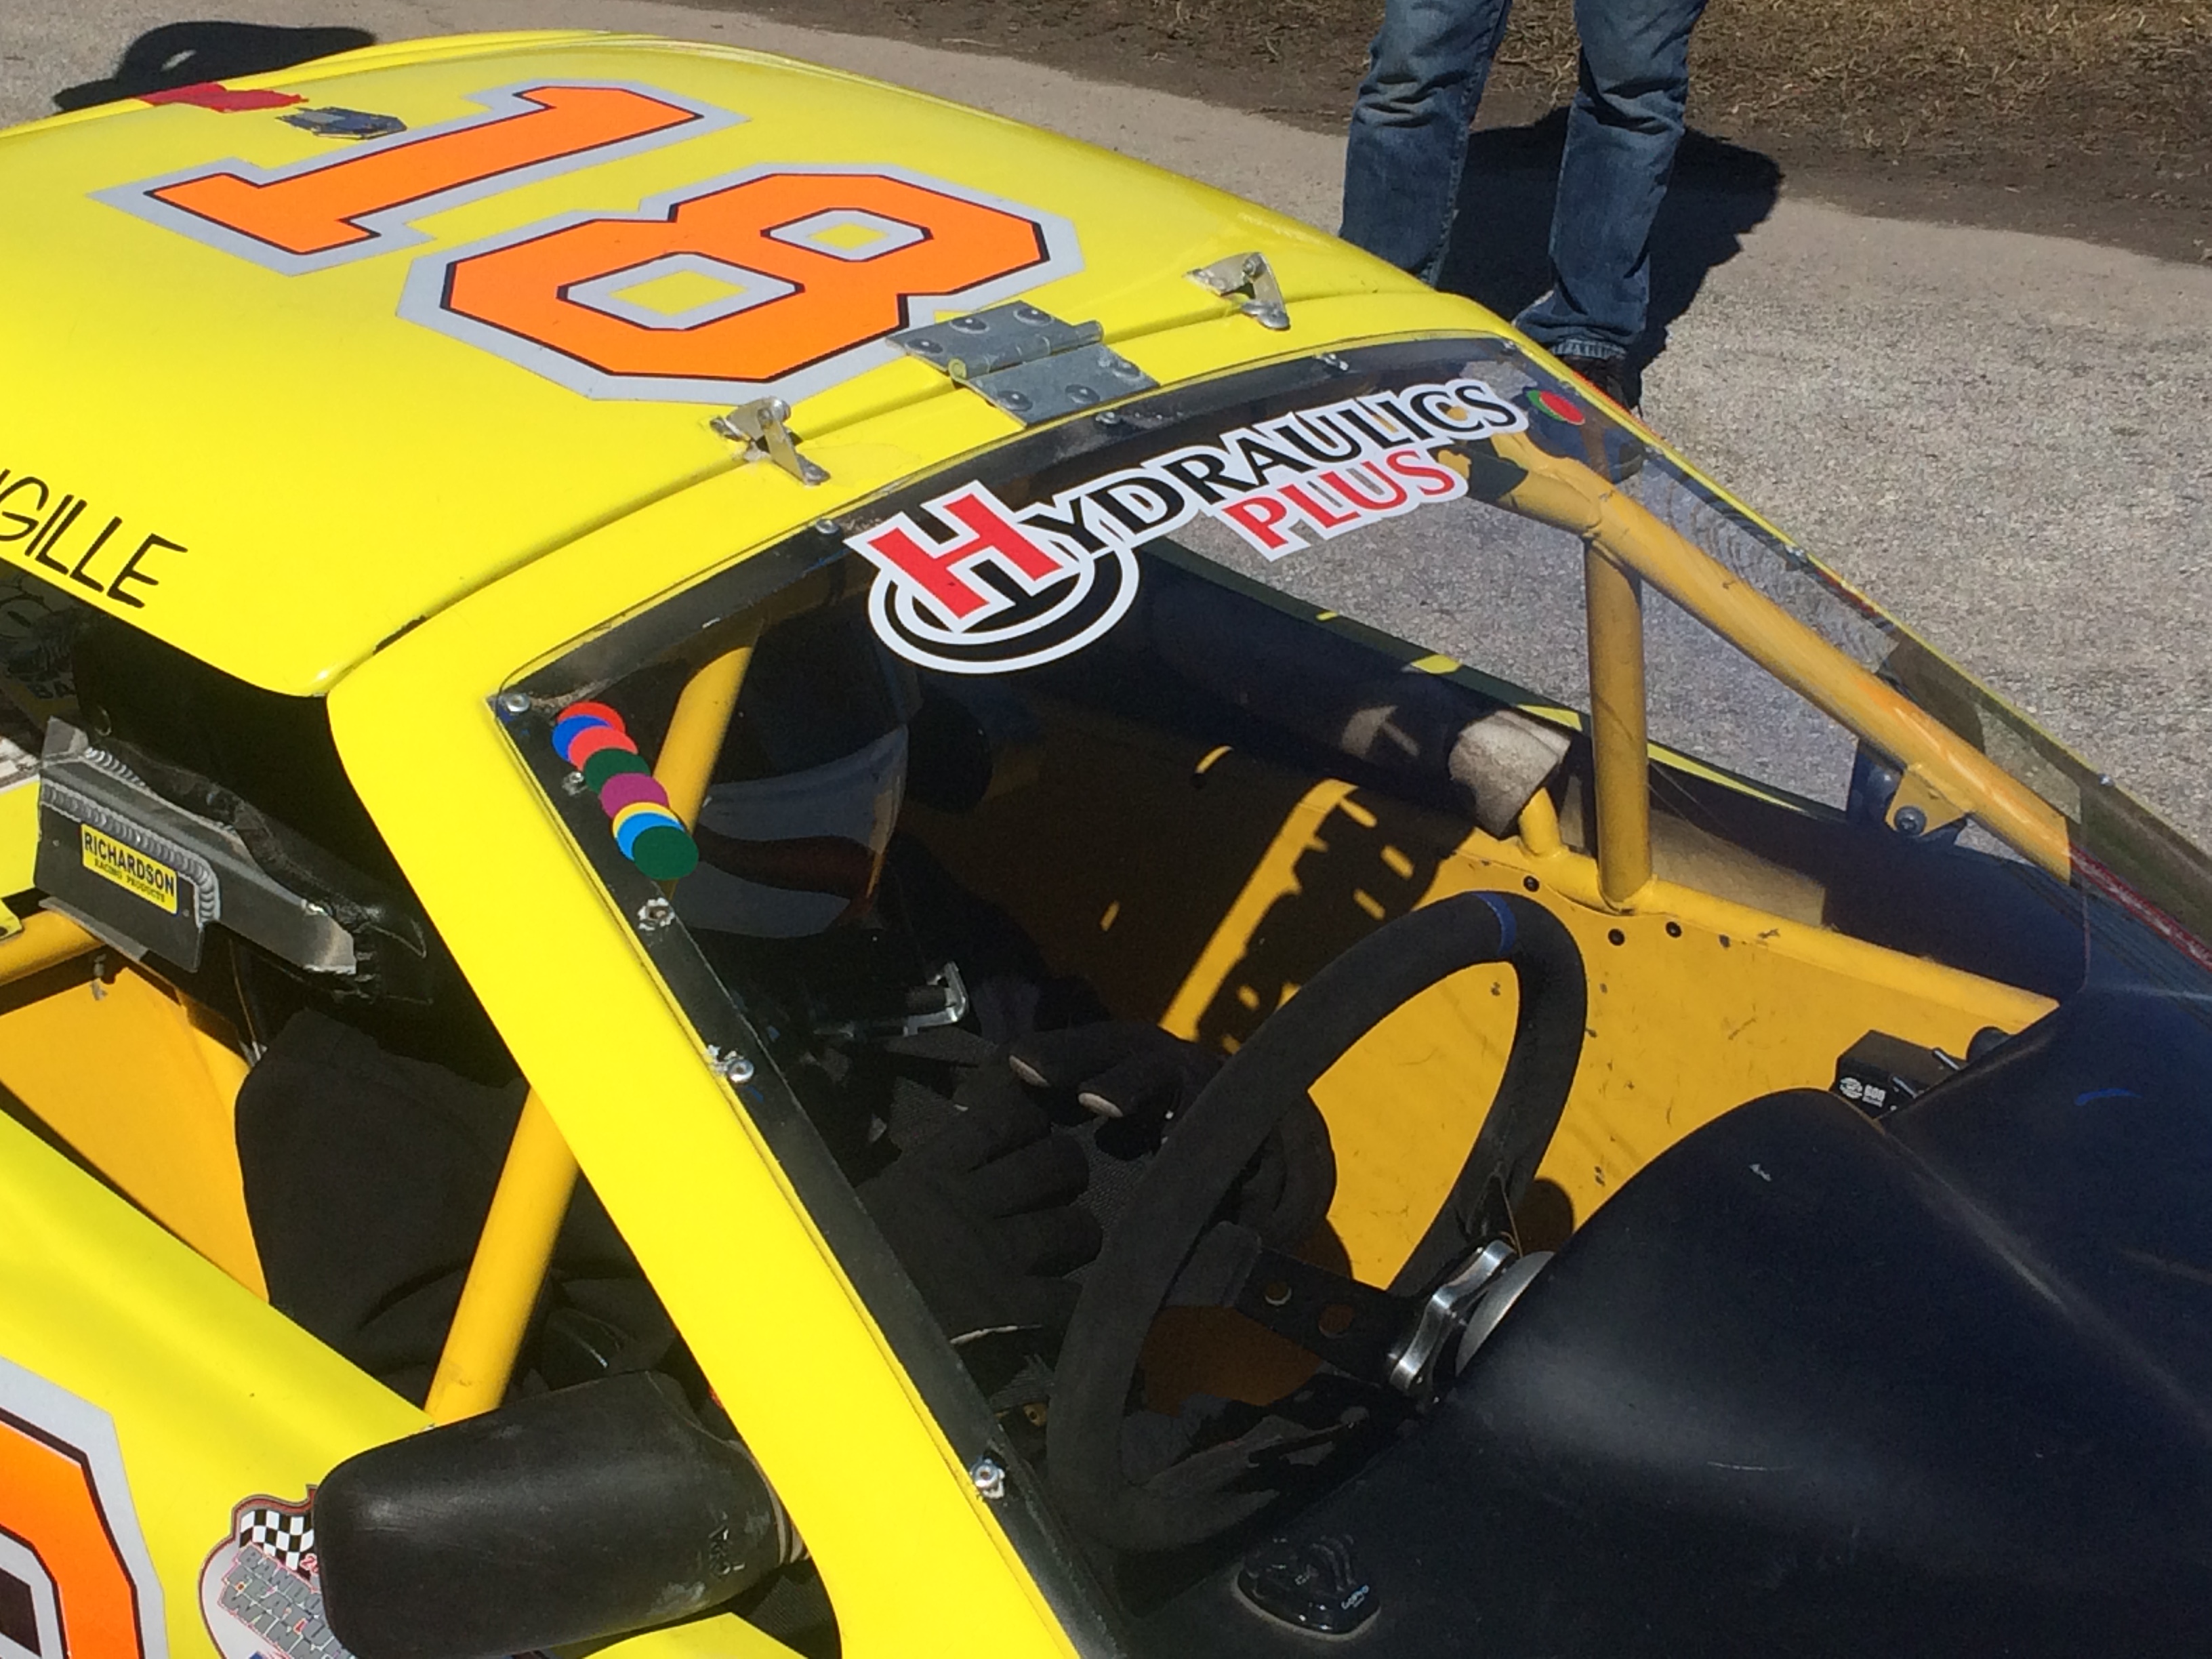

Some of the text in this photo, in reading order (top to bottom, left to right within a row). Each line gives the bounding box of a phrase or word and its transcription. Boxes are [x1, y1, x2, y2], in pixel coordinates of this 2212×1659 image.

[129, 80, 1067, 390] 18
[0, 468, 188, 609] GILLE
[1220, 449, 1457, 552] PLUS
[85, 832, 174, 897] RICHARDSON
[237, 1545, 327, 1624] BANDO
